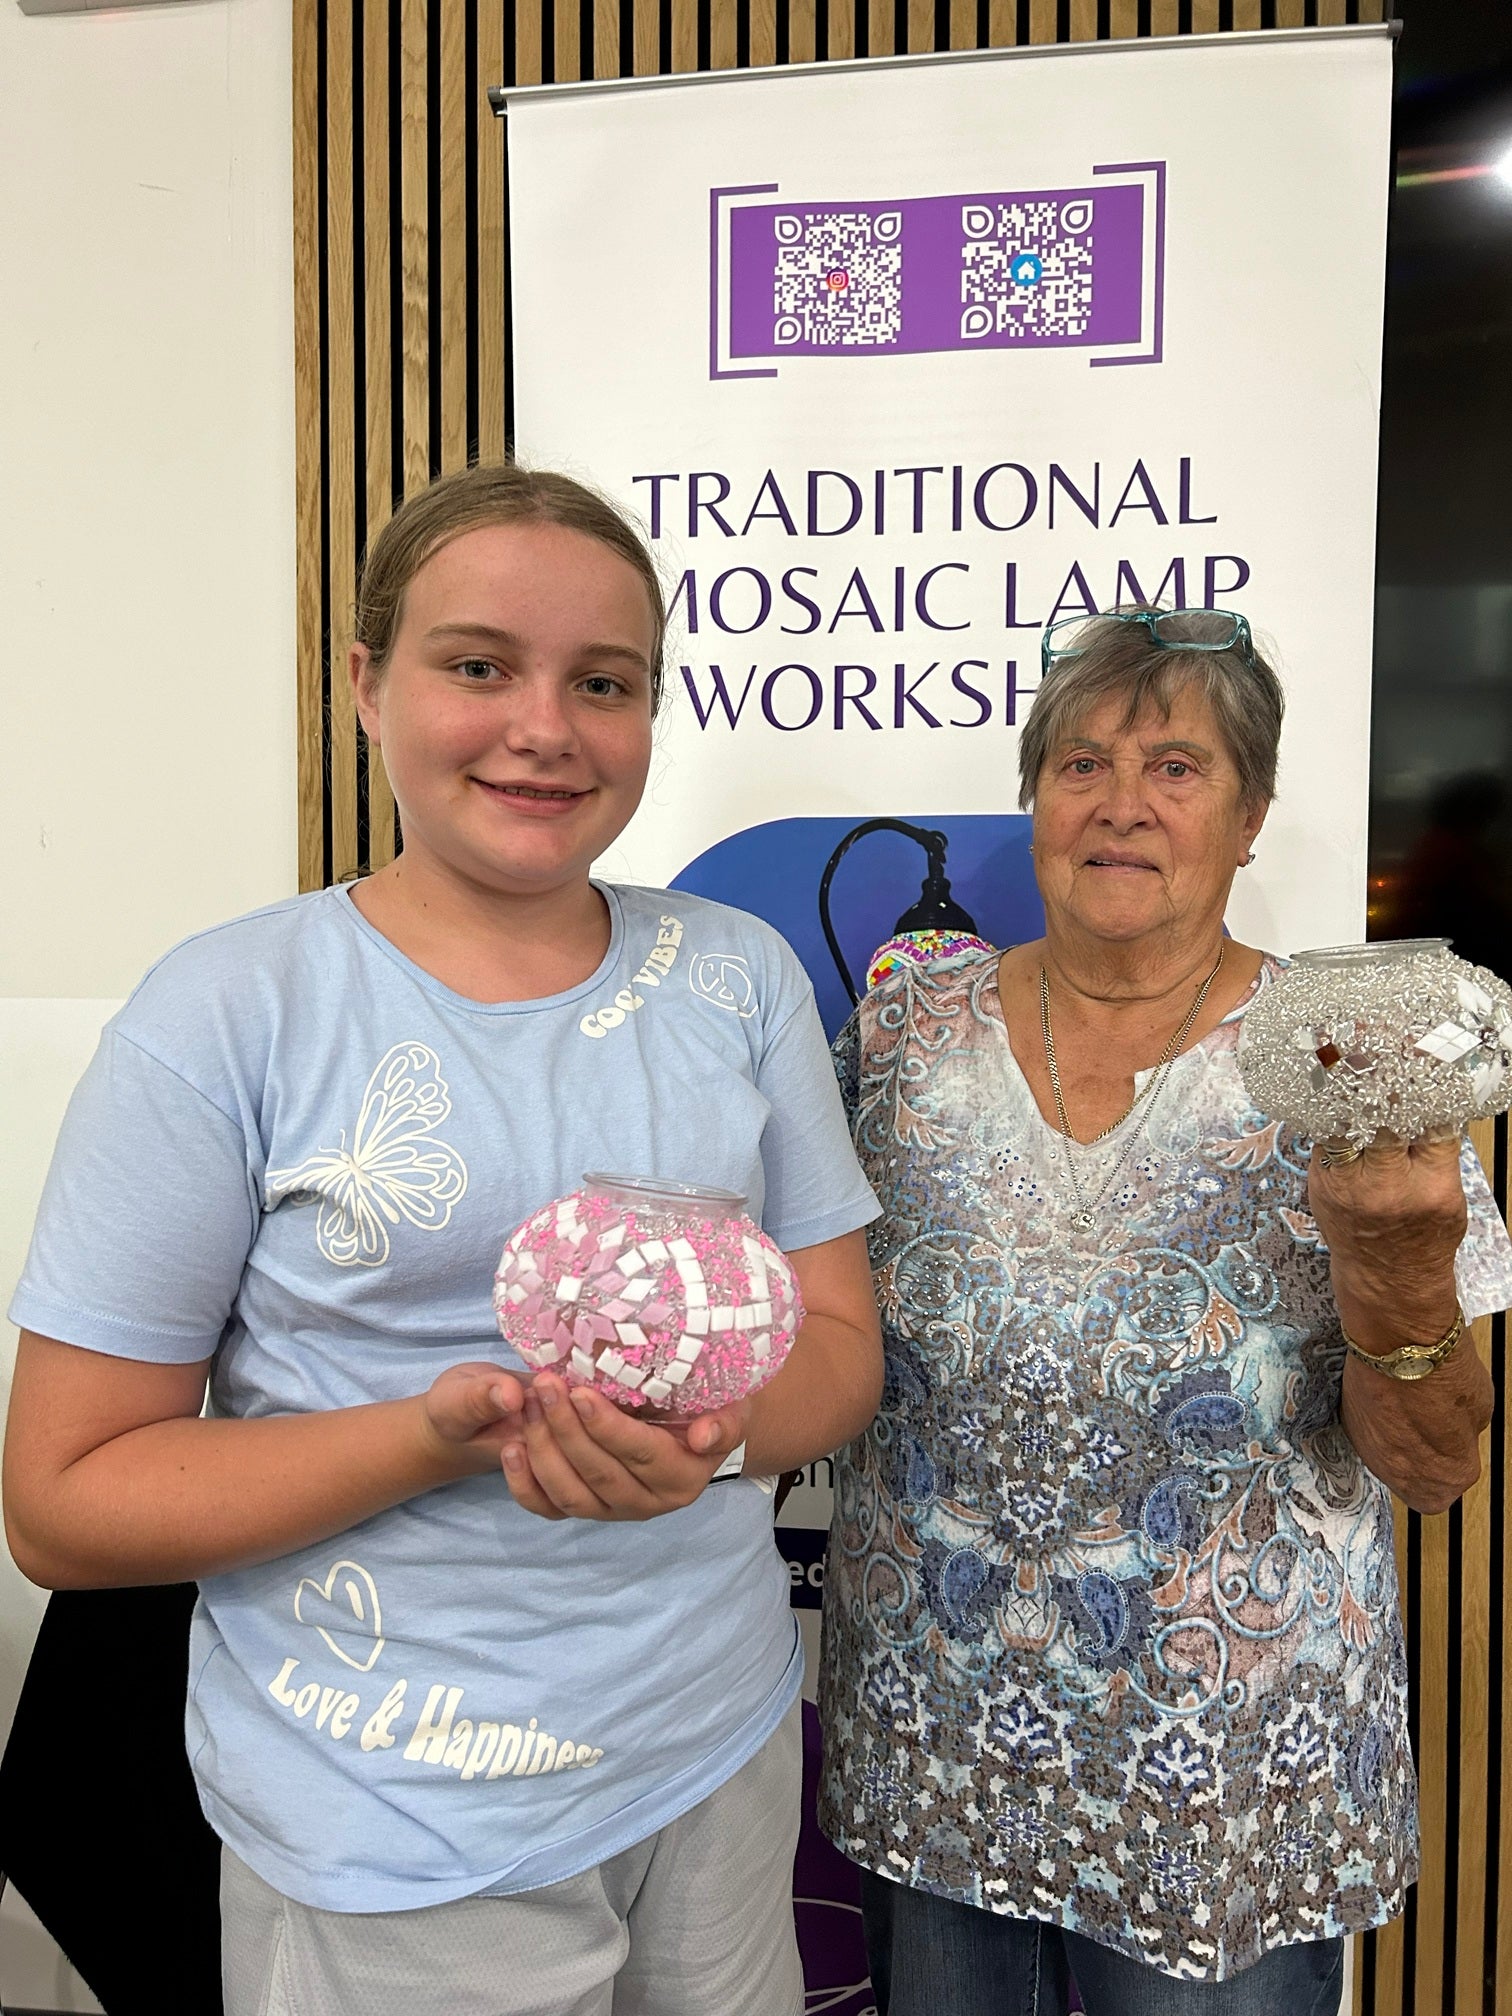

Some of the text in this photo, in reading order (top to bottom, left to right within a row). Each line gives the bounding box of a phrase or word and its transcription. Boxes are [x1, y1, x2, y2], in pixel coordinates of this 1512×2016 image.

[632, 457, 1218, 539] TRADITIONAL
[1005, 555, 1250, 628] LAMP
[680, 660, 1038, 731] WORKSH
[631, 915, 684, 987] VIBES
[268, 1658, 604, 1780] Love & Happiness
